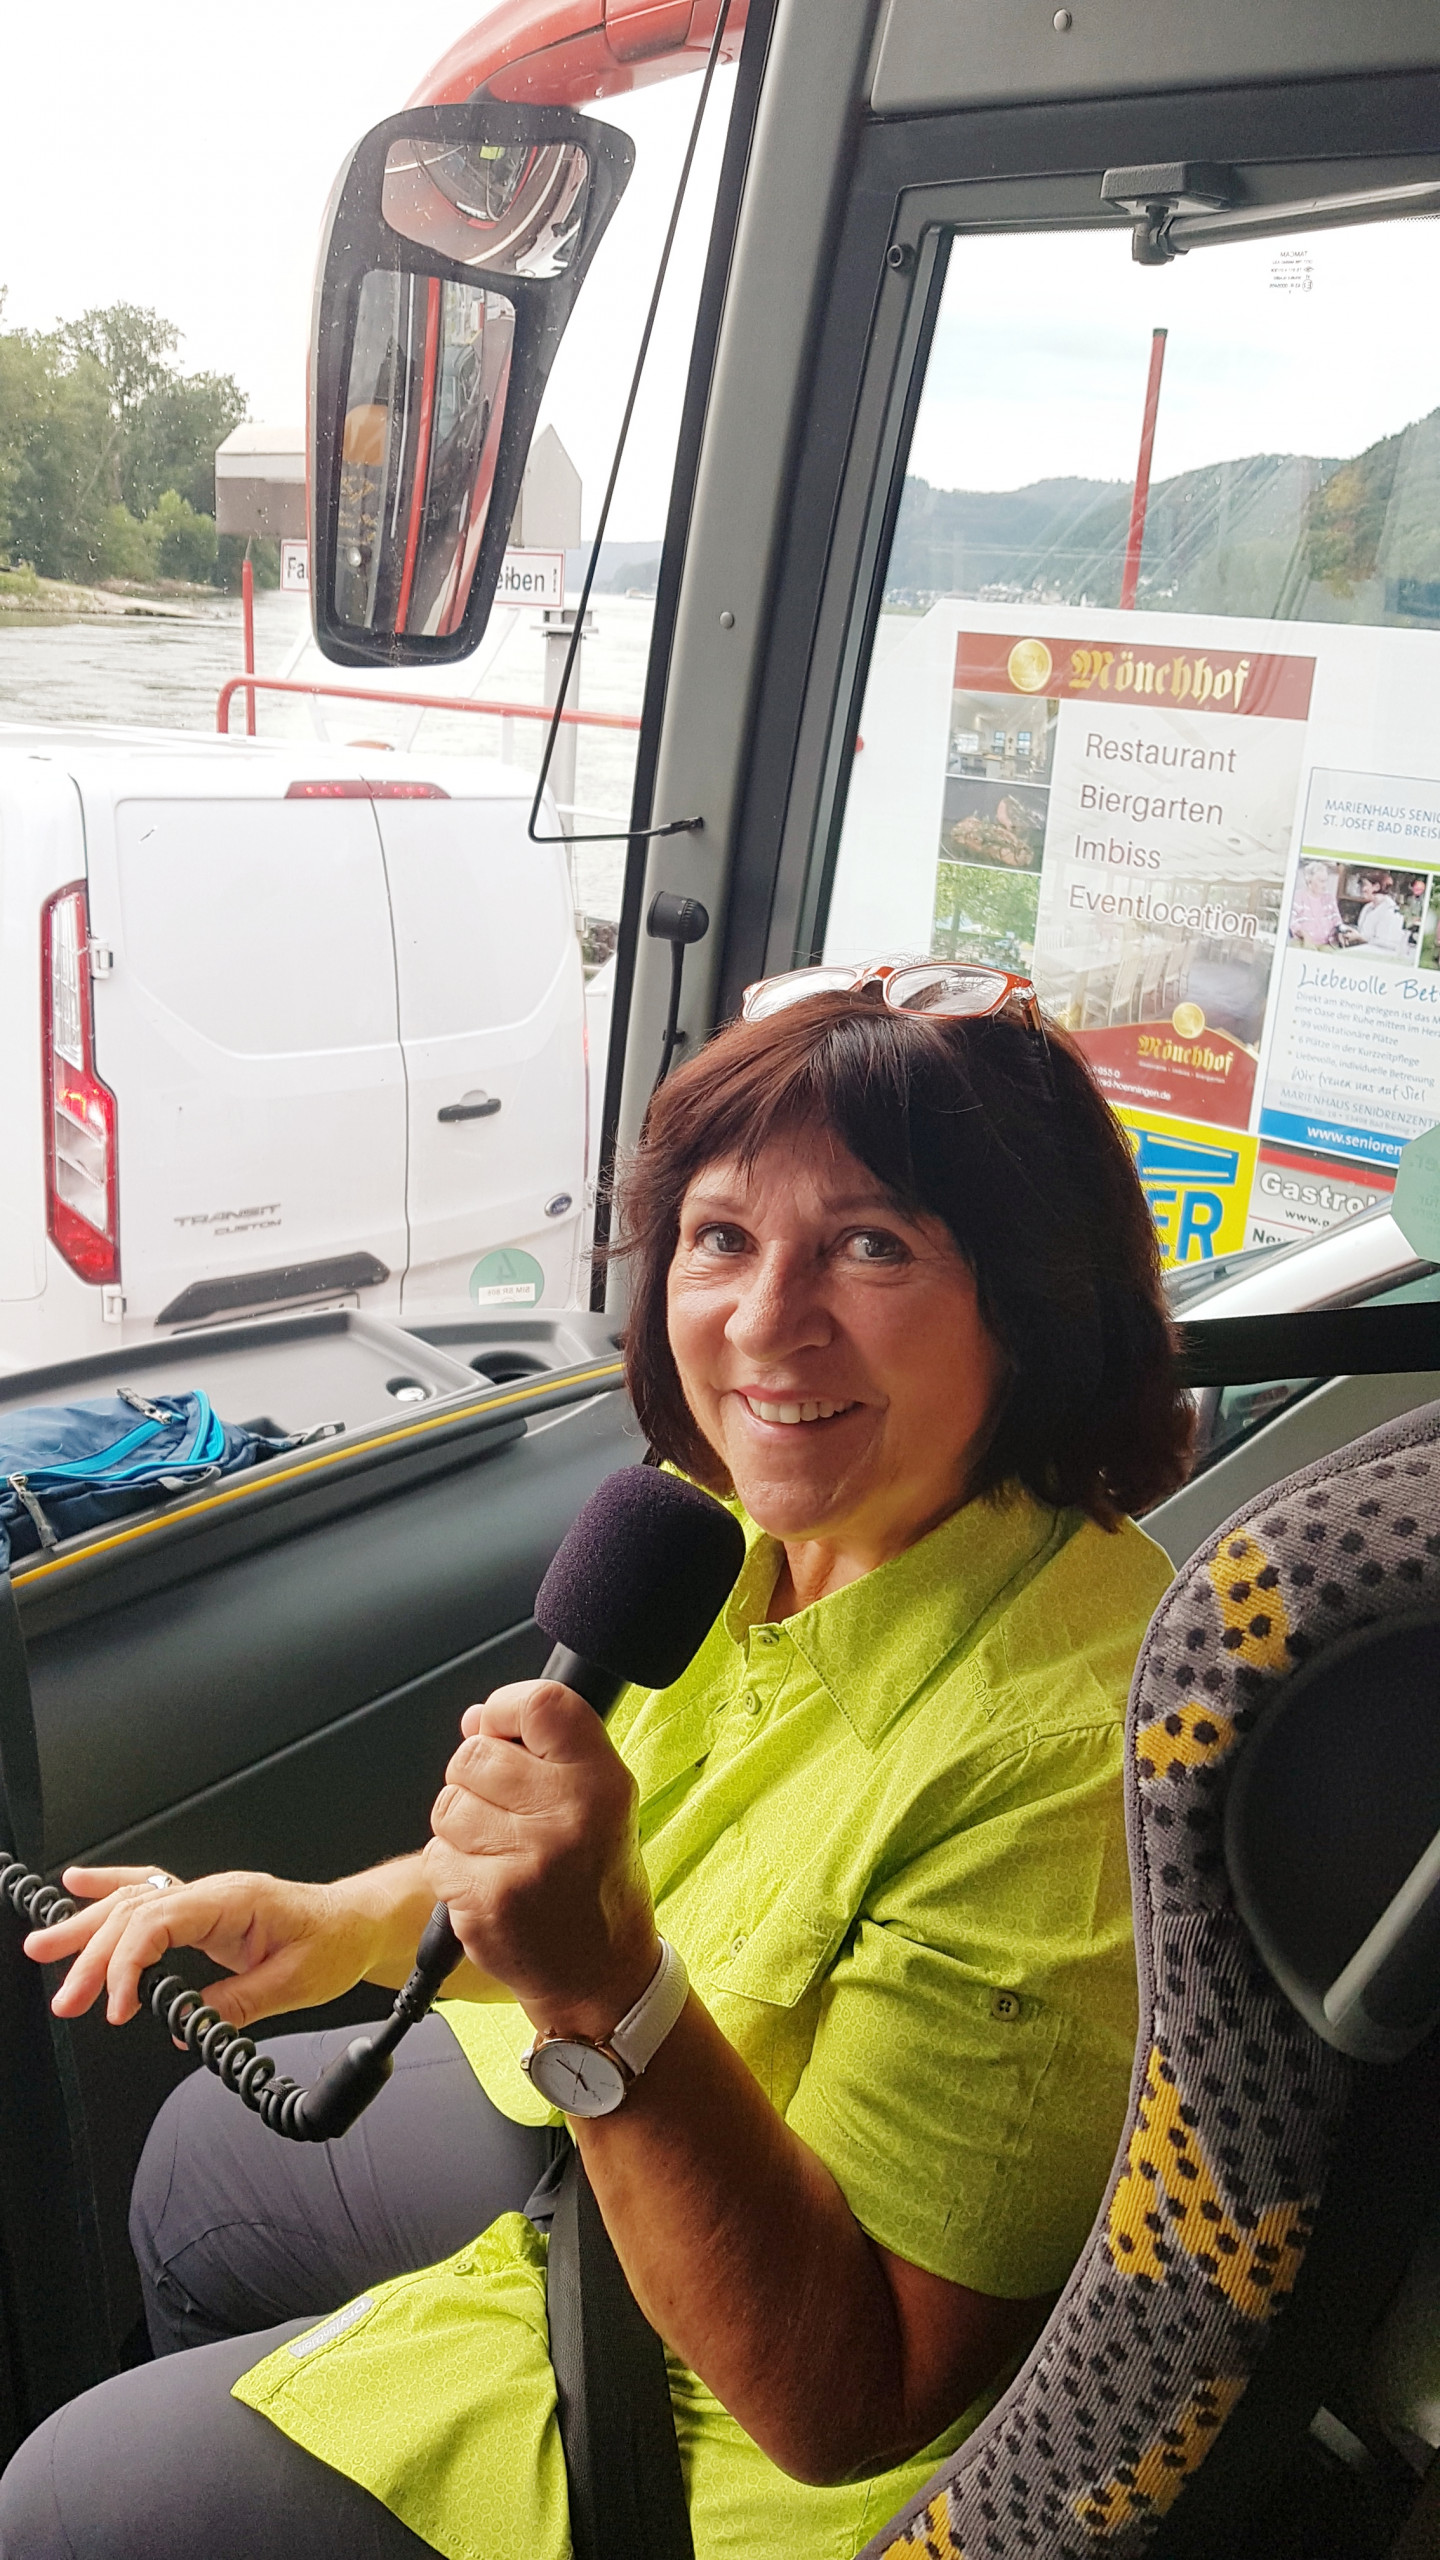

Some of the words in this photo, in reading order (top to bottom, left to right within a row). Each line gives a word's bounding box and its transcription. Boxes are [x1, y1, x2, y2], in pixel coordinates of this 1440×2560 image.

[1069, 649, 1249, 709] Mönchhof
[1086, 733, 1237, 774] Restaurant
[1080, 784, 1224, 826] Biergarten
[1325, 799, 1406, 819] MARIENHAUS
[1323, 814, 1338, 827] ST.
[1340, 816, 1374, 831] JOSEF
[1377, 821, 1402, 835] BAD
[1405, 824, 1440, 840] BREIS
[1075, 834, 1161, 870] Imbiss
[1068, 884, 1259, 940] Eventlocation
[1297, 963, 1389, 995] Liebevolle
[1394, 977, 1440, 1003] Bet
[1294, 1005, 1313, 1014] eine
[1314, 1007, 1335, 1017] Oase
[1336, 1010, 1351, 1020] der
[1353, 1014, 1375, 1026] Ruhe
[1376, 1018, 1406, 1032] mitten
[1408, 1024, 1420, 1034] im
[1296, 991, 1322, 1003] Direkt
[1323, 997, 1337, 1006] am
[1339, 999, 1363, 1010] Rhein
[1365, 1004, 1399, 1019] gelegen
[1401, 1010, 1412, 1020] ist
[1414, 1012, 1430, 1023] das
[1300, 1019, 1312, 1029] 99
[1313, 1022, 1371, 1042] vollstationäre
[1372, 1033, 1399, 1047] Plätze
[1138, 1034, 1235, 1077] Mönchhof
[1305, 1036, 1331, 1050] Plätze
[1332, 1041, 1340, 1050] in
[1342, 1042, 1356, 1054] der
[1358, 1046, 1420, 1068] Kurzzeitpflege
[1292, 1066, 1313, 1082] Wir
[1318, 1071, 1351, 1088] freuen
[1355, 1080, 1374, 1094] uns
[1378, 1081, 1398, 1101] auf
[1296, 1051, 1338, 1068] Liebevolle,
[1339, 1058, 1388, 1077] individuelle
[1389, 1069, 1436, 1088] Betreuung
[1280, 1088, 1350, 1110] MARIENHAUS
[173, 1202, 281, 1227] TRANSIT
[213, 1218, 282, 1236] CUSTOM
